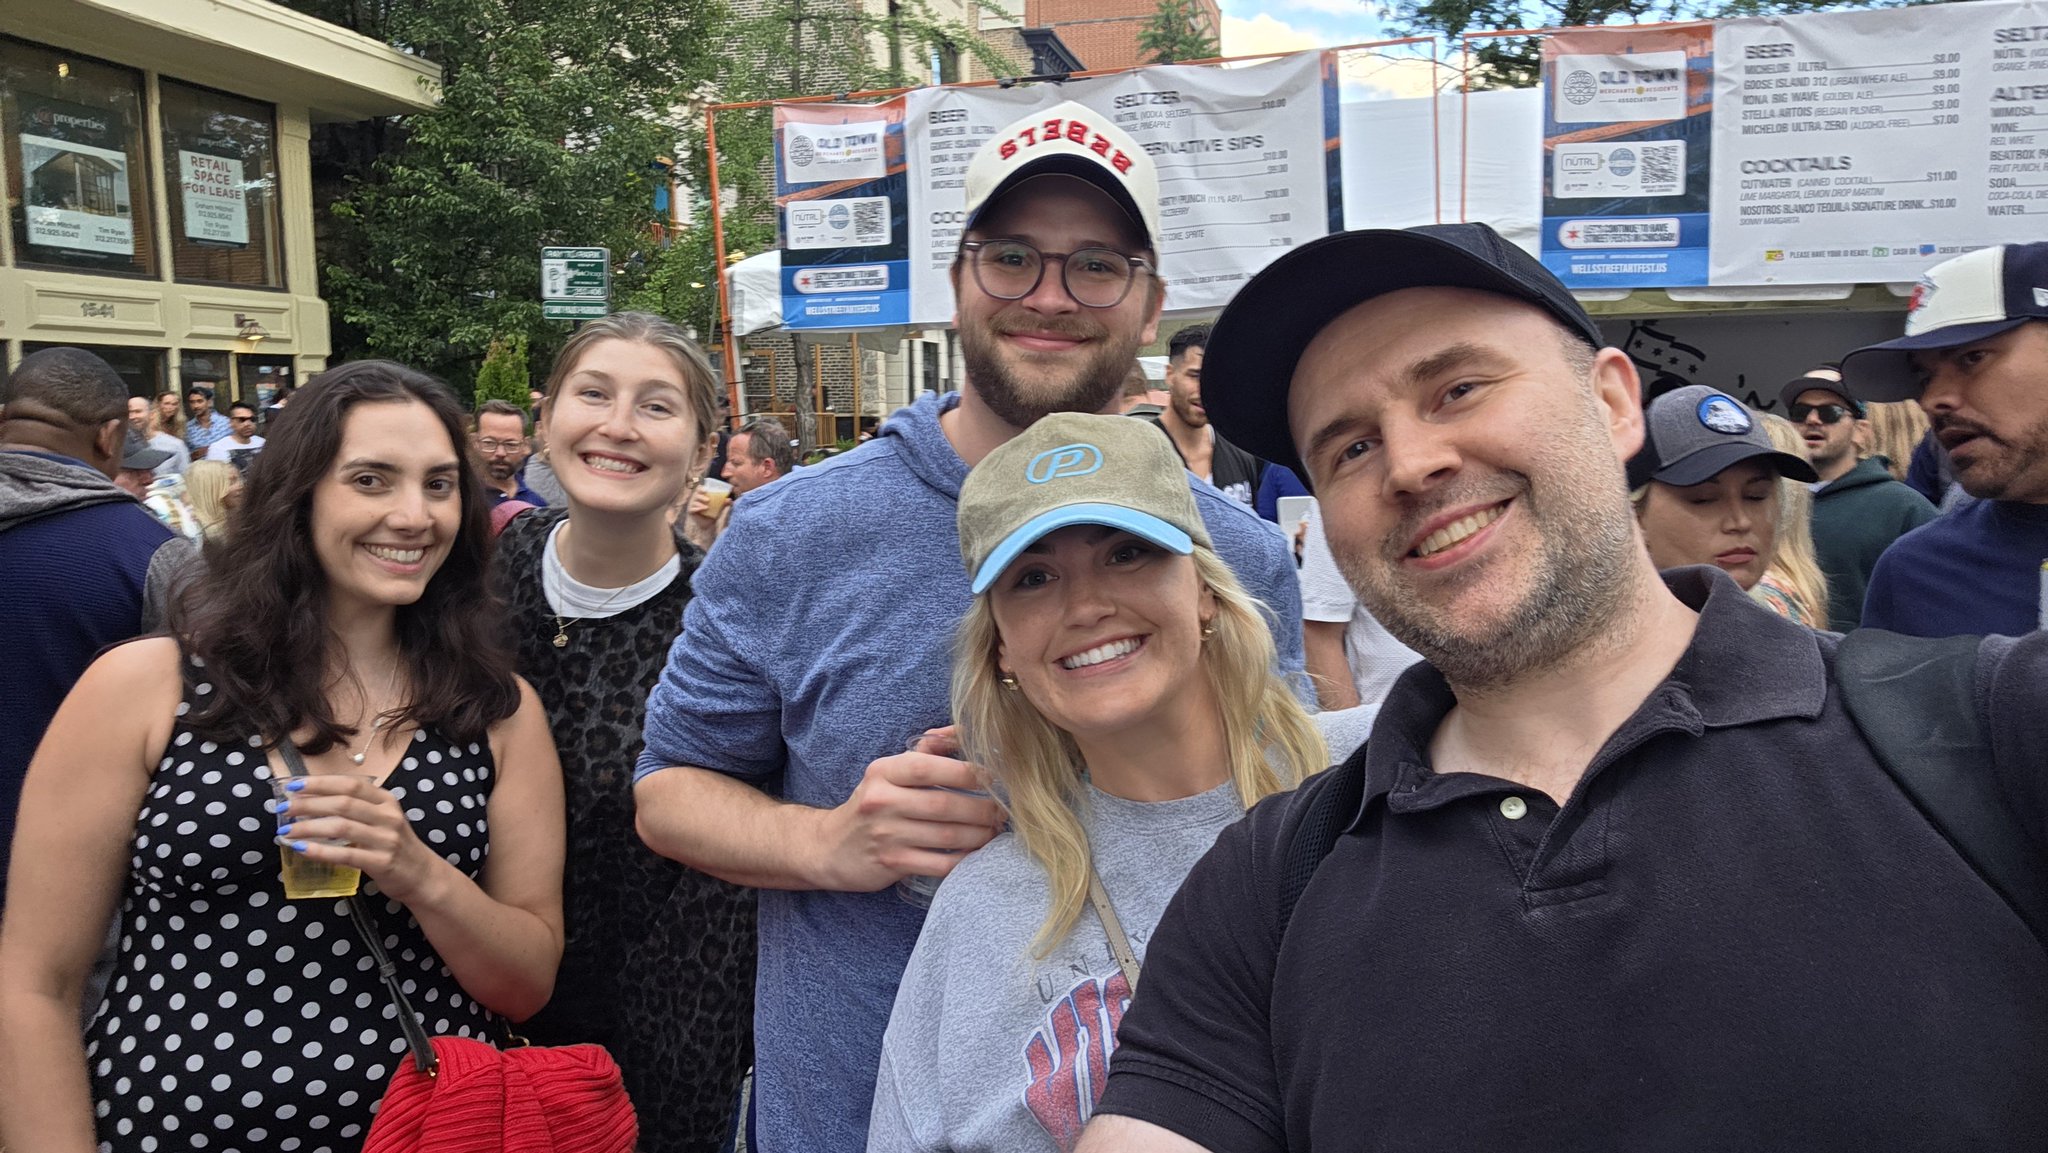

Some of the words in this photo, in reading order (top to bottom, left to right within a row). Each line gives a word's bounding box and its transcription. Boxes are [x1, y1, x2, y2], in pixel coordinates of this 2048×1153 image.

[1744, 43, 1795, 59] BEER
[1744, 63, 1791, 74] MICHELOB
[1797, 61, 1827, 72] ULTRA
[1933, 52, 1960, 64] $8.00
[1600, 70, 1630, 84] OLD
[1632, 68, 1679, 83] TOWN
[1744, 79, 1774, 90] GOOSE
[1775, 77, 1810, 88] ISLAND
[1812, 76, 1828, 86] 312
[1860, 74, 1889, 84] WHEAT
[1933, 68, 1960, 79] $9.00
[1113, 90, 1181, 110] SELTZER
[1742, 94, 1769, 105] KONA
[1771, 92, 1788, 104] BIG
[1790, 91, 1820, 102] WAVE
[1932, 83, 1960, 95] $9.00
[928, 109, 968, 124] BEER
[1742, 109, 1776, 120] STELLA
[1777, 106, 1813, 118] ARTOIS
[1932, 98, 1960, 110] $9.00
[1990, 106, 2035, 118] MIMOSA
[1742, 122, 1789, 135] MICHELOB
[1791, 121, 1822, 132] ULTRA
[1823, 120, 1848, 131] ZERO
[1932, 114, 1960, 126] $7.00
[1990, 122, 2020, 133] WINE
[1227, 135, 1264, 151] SIPS
[2008, 135, 2036, 145] WHITE
[1990, 149, 2036, 161] BEATBOX
[190, 155, 232, 173] RETAIL
[1740, 156, 1852, 174] COCKTAILS
[1988, 164, 2012, 173] FRUIT
[194, 169, 231, 186] SPACE
[1740, 178, 1792, 190] CUTWATER
[1797, 177, 1831, 188] (CANNED
[1926, 170, 1958, 182] $11.00
[1988, 177, 2017, 188] SODA
[182, 182, 206, 195] FOR
[209, 186, 242, 200] LEASE
[1740, 192, 1758, 202] LIME
[1804, 190, 1831, 199] LEMON
[1832, 188, 1852, 198] DROP
[1852, 187, 1885, 198] MARTINI
[1740, 204, 1782, 216] NOSOTROS
[1782, 203, 1815, 214] BLANCO
[1816, 202, 1850, 213] TEQUILA
[1852, 200, 1896, 212] SIGNATURE
[1898, 199, 1924, 210] DRINK
[1930, 198, 1957, 209] $10.00
[1988, 204, 2025, 216] WATER
